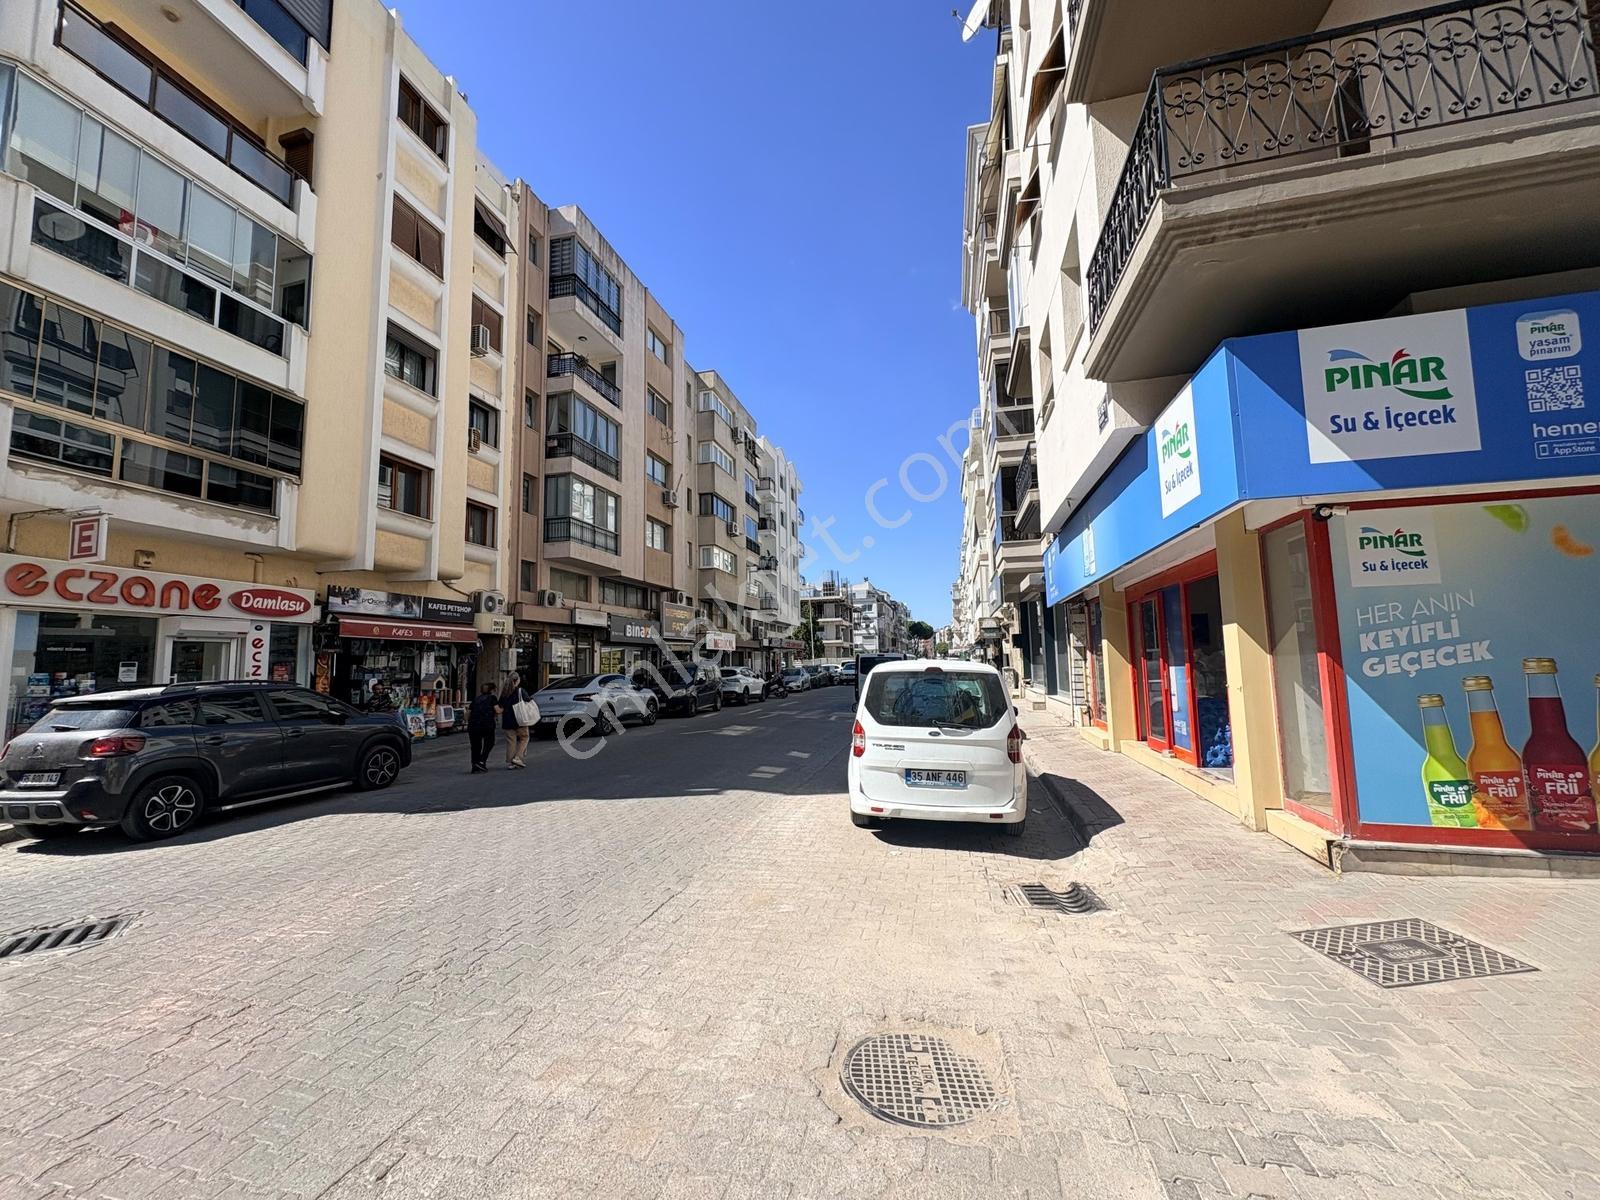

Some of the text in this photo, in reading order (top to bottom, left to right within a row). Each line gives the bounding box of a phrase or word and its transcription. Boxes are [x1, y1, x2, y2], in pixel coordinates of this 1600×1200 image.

[1329, 404, 1457, 434] Su & İçecek
[1533, 421, 1600, 438] heme
[1553, 447, 1572, 455] App
[77, 523, 95, 555] E
[1362, 558, 1429, 572] Su & İçecek
[4, 562, 306, 613] eczane Damlasu
[428, 602, 472, 613] KAFES PETSHOP
[1356, 589, 1476, 627] HER ANIN
[392, 627, 413, 637] KAFES
[1359, 613, 1461, 653] KEYİFLİ
[251, 637, 264, 680] ecz
[1362, 639, 1495, 678] GEÇECEK
[911, 771, 964, 783] 35 ANF 446
